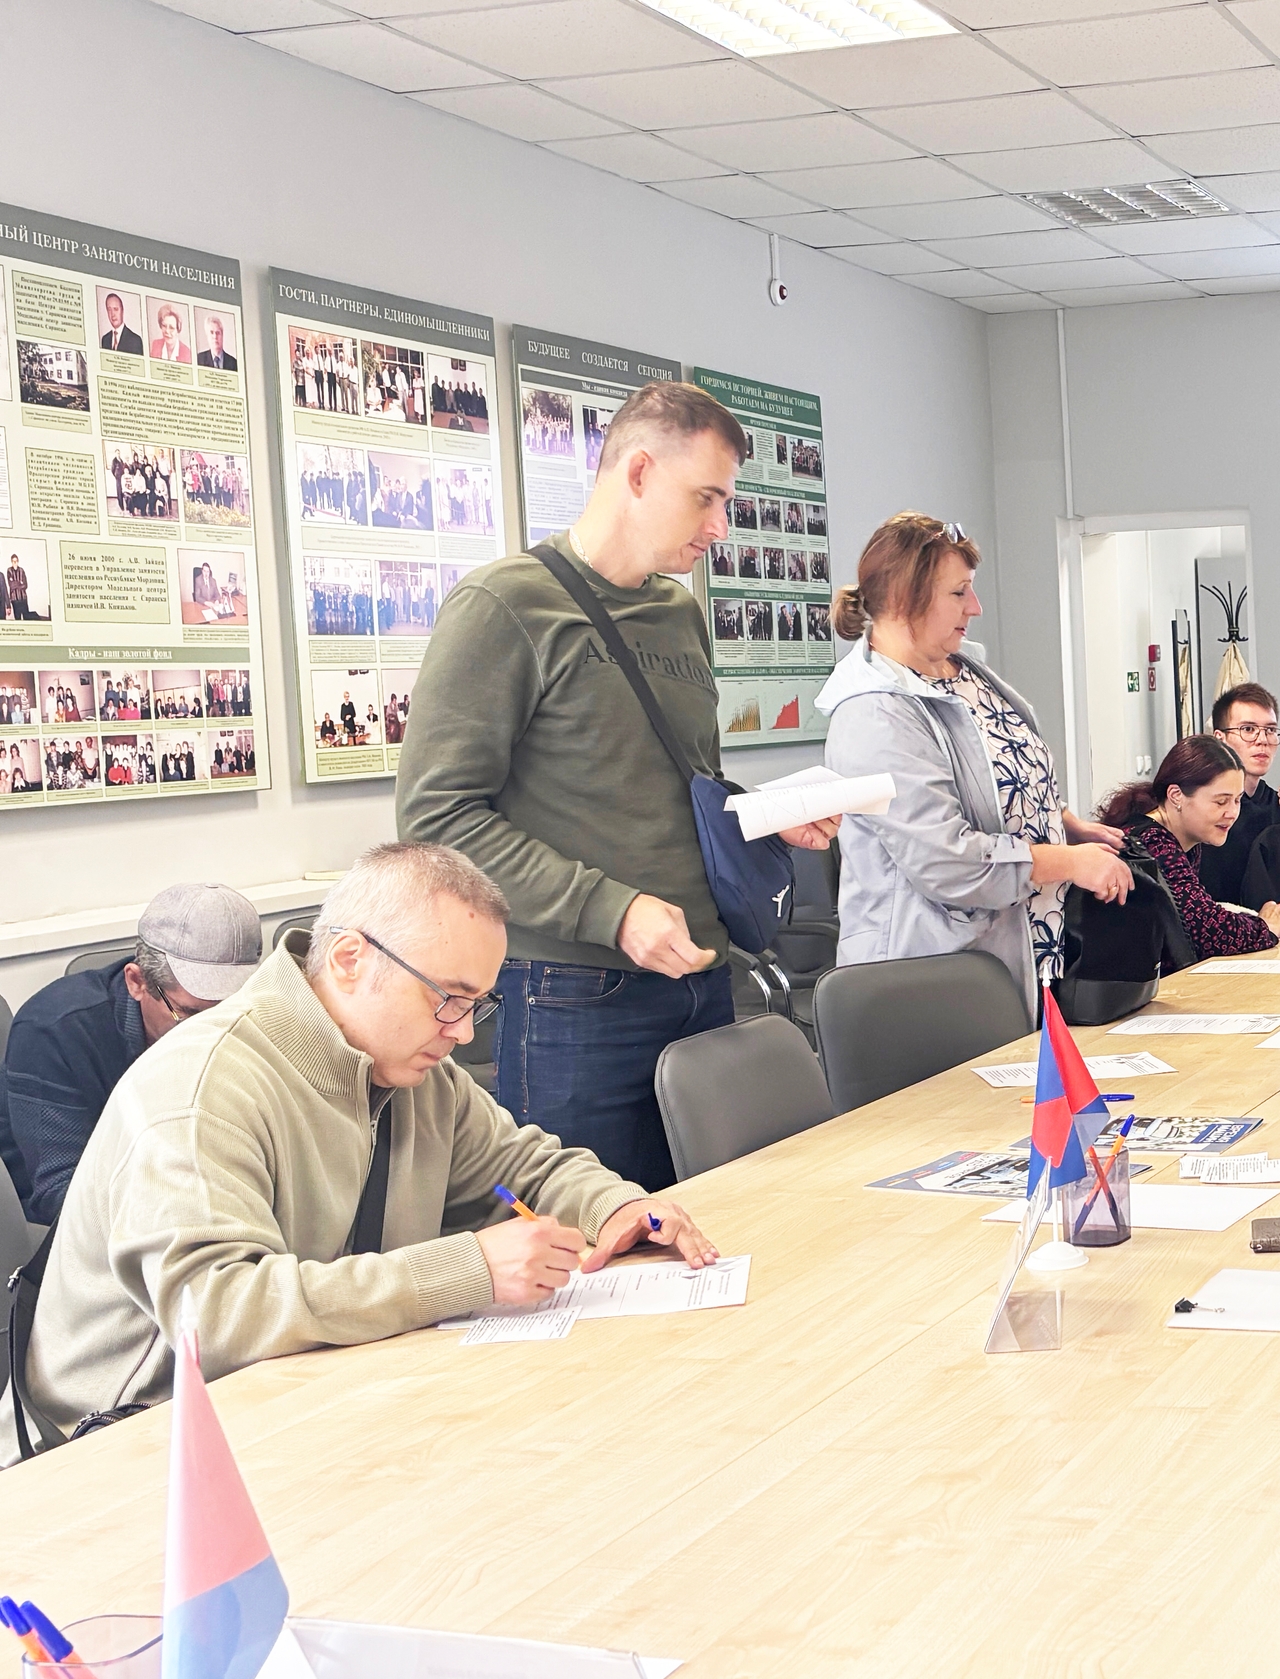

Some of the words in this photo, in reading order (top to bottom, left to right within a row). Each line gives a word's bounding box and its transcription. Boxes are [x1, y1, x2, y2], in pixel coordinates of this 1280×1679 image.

[0, 224, 28, 243] ЫЙ
[32, 231, 79, 254] ЦЕНТР
[82, 243, 159, 273] ЗАНЯТОСТИ
[162, 261, 235, 289] НАСЕЛЕНИЯ
[278, 284, 319, 305] ГОСТИ,
[321, 294, 382, 319] ПАРТНЕРЫ,
[384, 307, 491, 341] ЕДИНОМЫШЛЕННИКИ
[528, 340, 571, 360] БУДУЩЕЕ
[581, 351, 629, 372] СОЗДАЕТСЯ
[637, 363, 673, 382] СЕГОДНЯ
[700, 375, 732, 390] ГОРДИМСЯ
[731, 395, 760, 410] РАБОТАЕМ
[68, 647, 97, 660] Кадры
[121, 648, 151, 659] золотой
[153, 648, 173, 660] фонд
